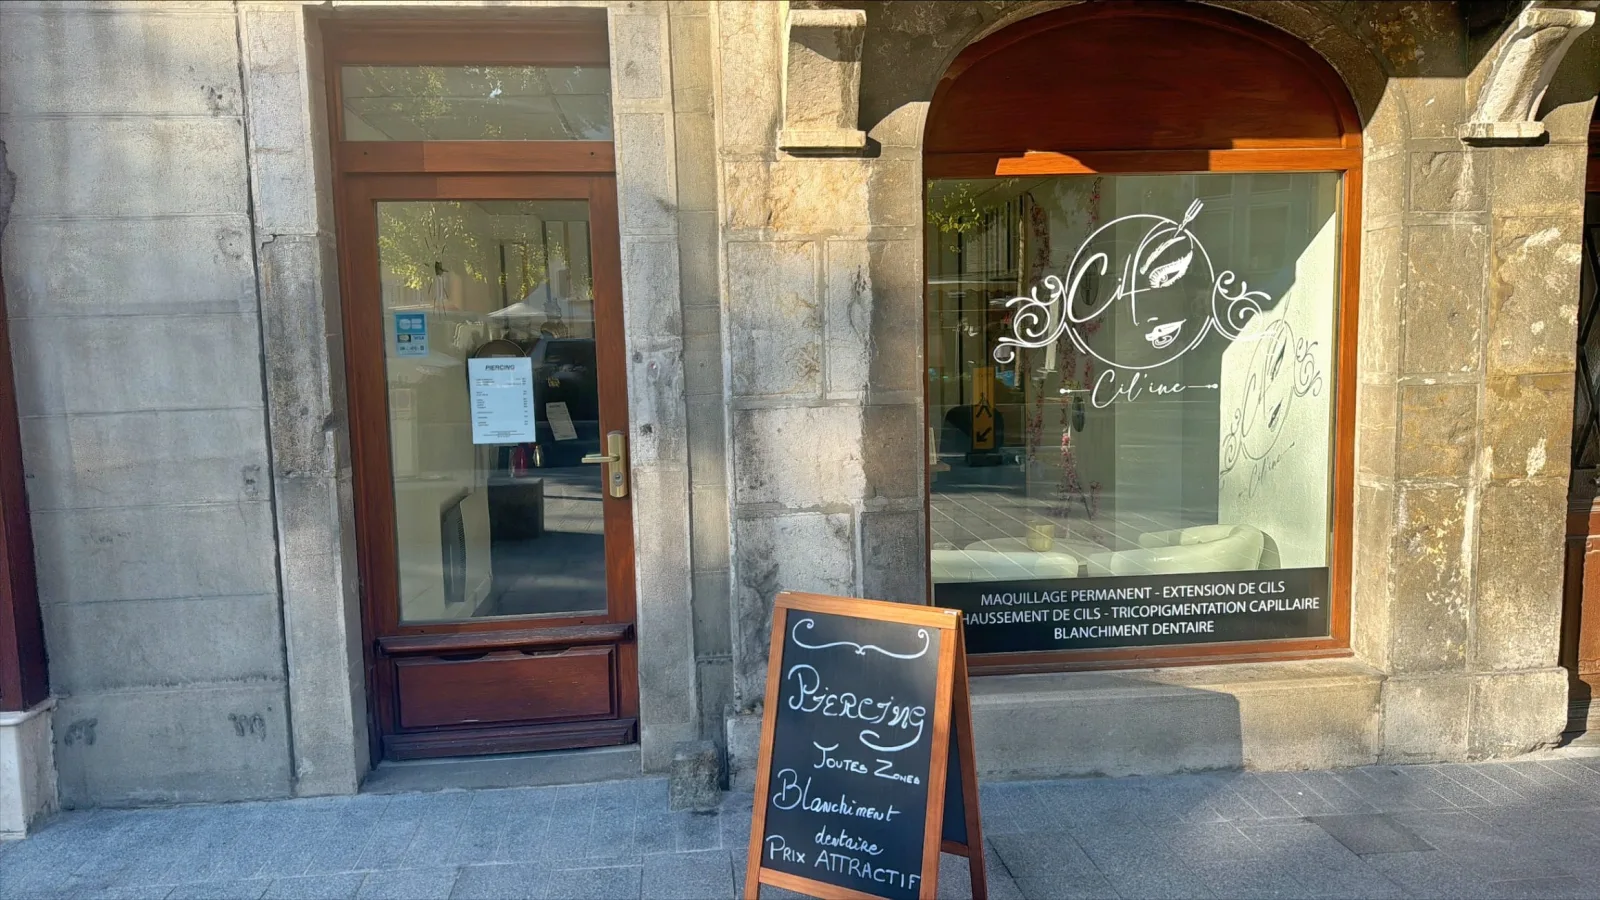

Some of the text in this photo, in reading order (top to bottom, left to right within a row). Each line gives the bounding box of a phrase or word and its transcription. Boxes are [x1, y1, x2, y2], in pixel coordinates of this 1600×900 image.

[980, 590, 1068, 606] MAQUILLAGE
[1071, 587, 1152, 602] PERMANENT
[1163, 583, 1235, 598] EXTENSION
[1238, 582, 1256, 595] DE
[1258, 580, 1286, 594] CILS
[1052, 609, 1071, 621] DE
[1073, 607, 1101, 621] CILS
[1111, 601, 1246, 619] TRICOPIGMENTATION
[1249, 597, 1320, 613] CAPILLAIRE
[1054, 620, 1215, 640] BLANCHIMENT DENTAIRE
[814, 825, 884, 855] dentaire
[814, 850, 921, 890] ATTRACTIF
